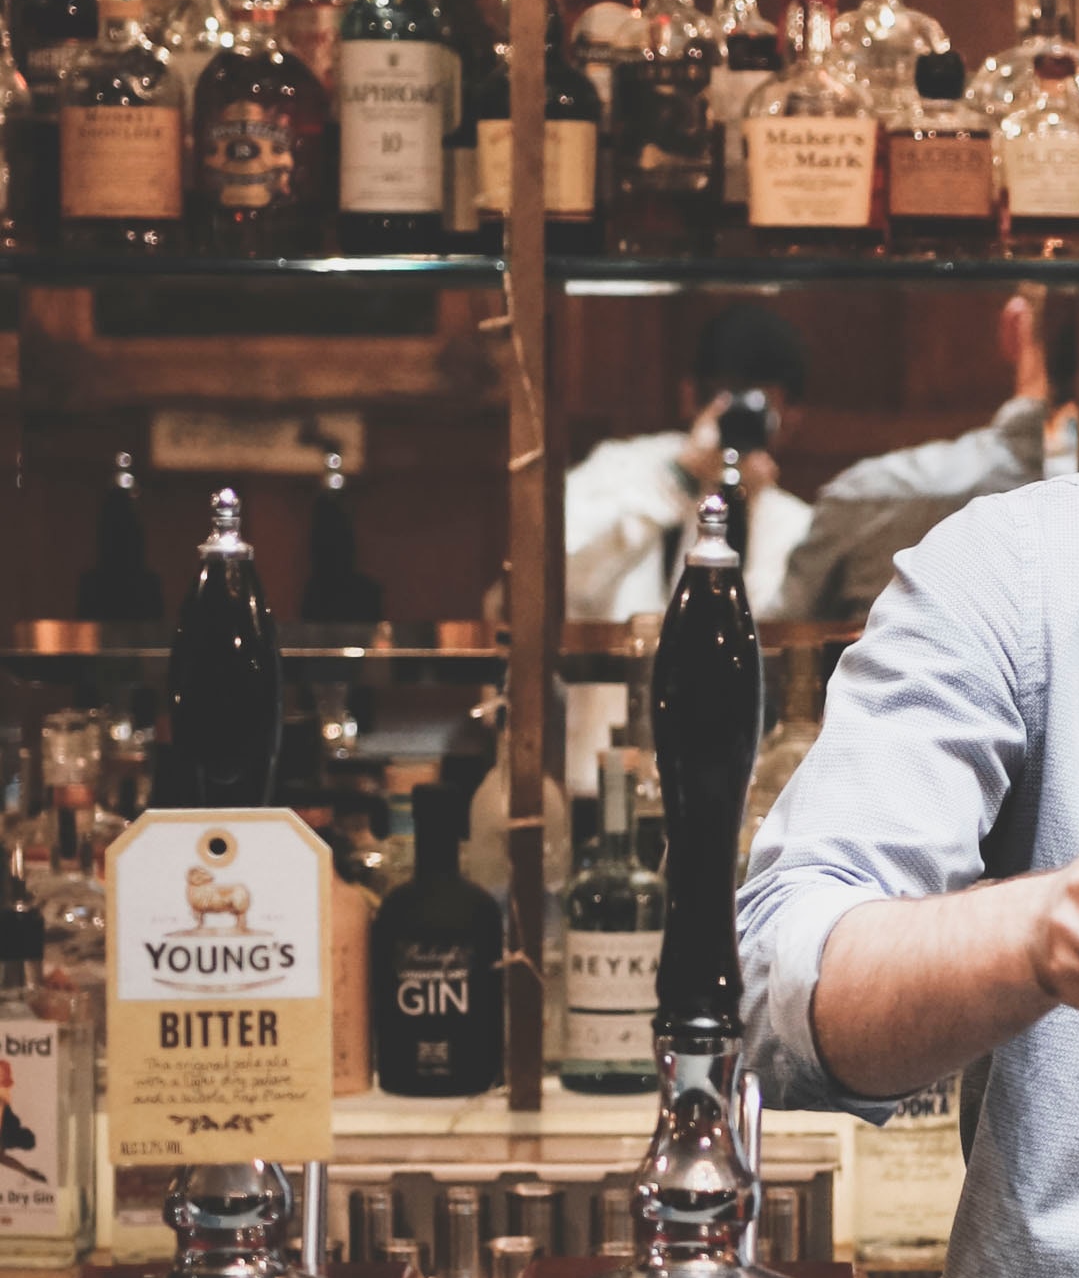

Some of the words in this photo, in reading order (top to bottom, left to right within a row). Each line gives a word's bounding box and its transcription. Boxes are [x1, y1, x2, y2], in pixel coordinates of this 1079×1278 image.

[795, 151, 864, 169] Mark
[144, 941, 296, 974] YOUNG'S
[397, 979, 471, 1017] GIN
[159, 1009, 279, 1049] BITTER
[6, 1035, 51, 1056] bird
[8, 1192, 29, 1207] Dry
[33, 1191, 54, 1205] Gin
